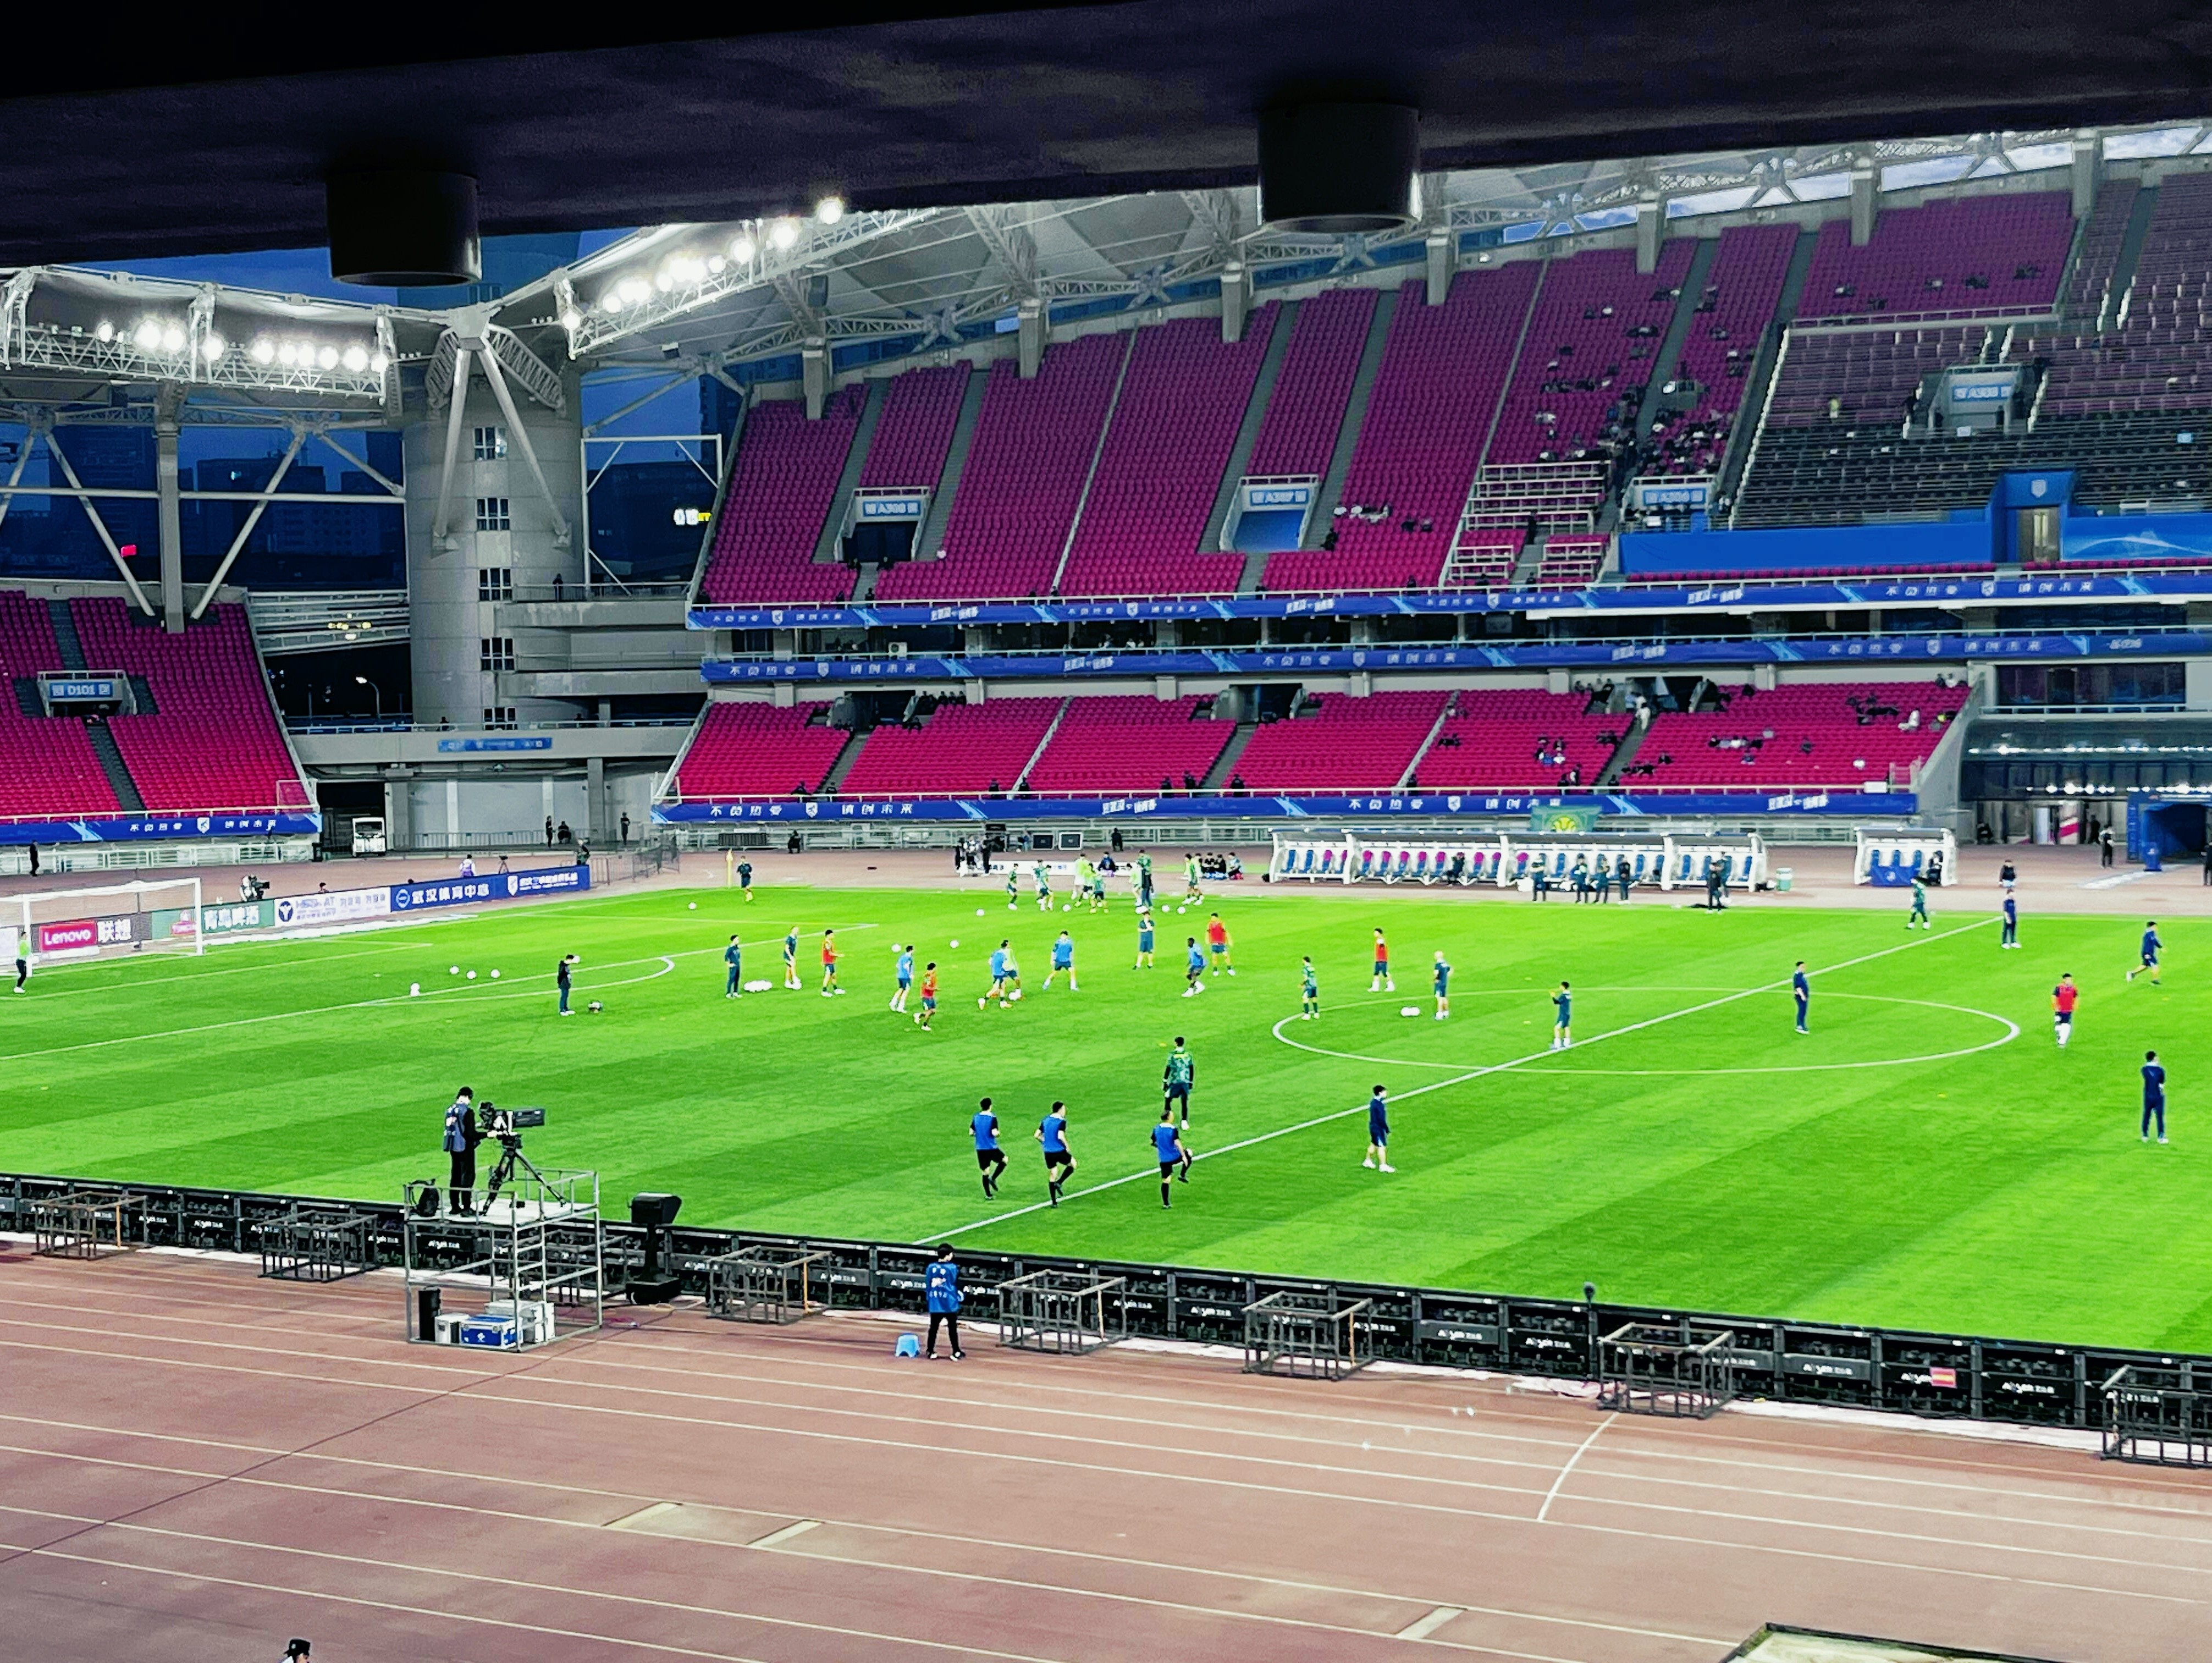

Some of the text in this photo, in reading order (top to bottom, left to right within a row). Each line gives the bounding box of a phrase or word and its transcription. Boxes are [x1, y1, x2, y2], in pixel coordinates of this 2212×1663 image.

[411, 883, 489, 904] 武汉体育中心
[44, 919, 132, 945] Lenovo 联想
